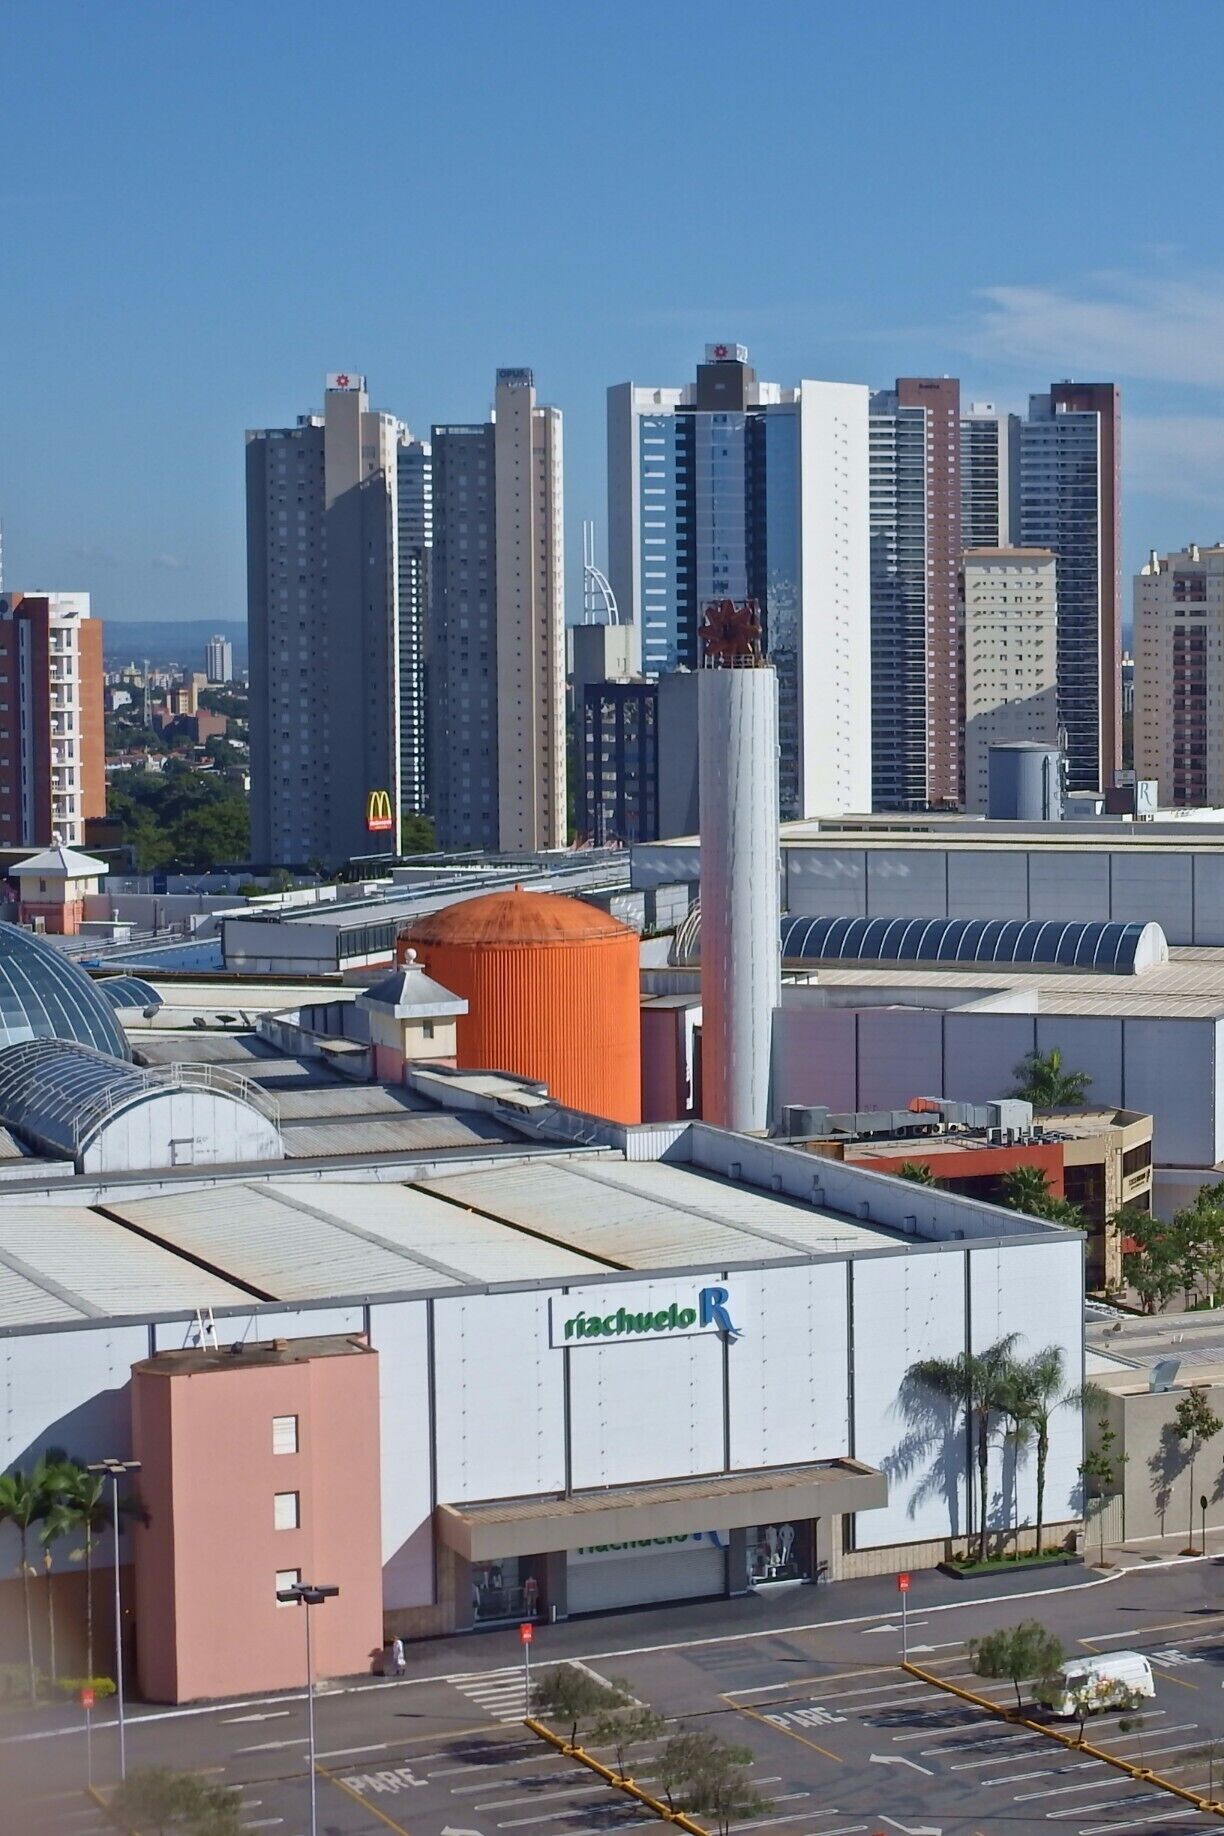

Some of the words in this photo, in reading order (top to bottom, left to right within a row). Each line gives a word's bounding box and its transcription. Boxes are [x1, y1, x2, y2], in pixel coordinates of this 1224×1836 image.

[1140, 783, 1152, 806] R
[1145, 1649, 1206, 1668] ARE
[763, 1706, 848, 1730] PARE
[340, 1767, 429, 1795] PARE
